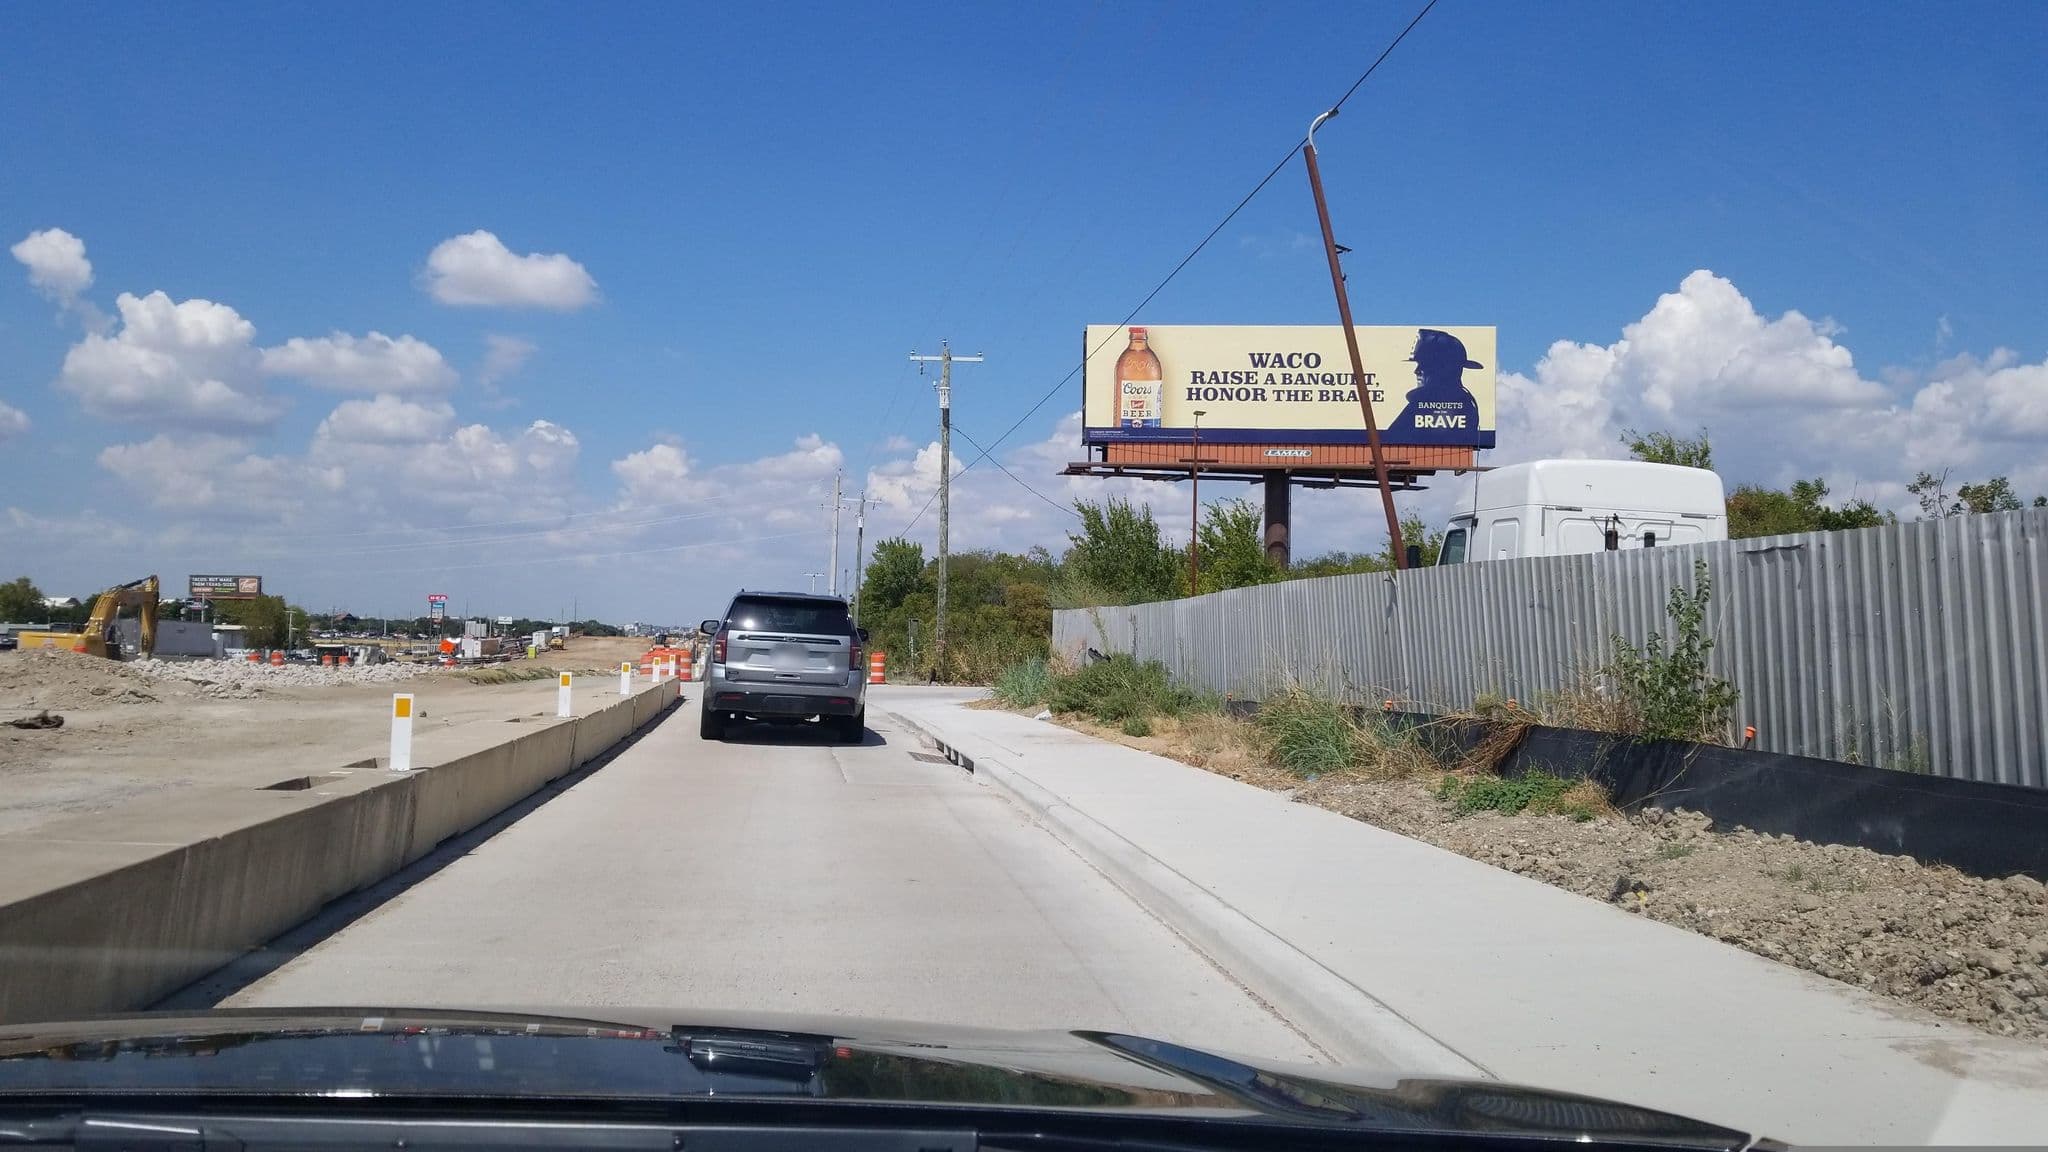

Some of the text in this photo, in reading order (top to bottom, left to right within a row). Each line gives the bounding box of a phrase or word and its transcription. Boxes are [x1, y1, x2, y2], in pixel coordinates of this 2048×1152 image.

[1248, 352, 1322, 369] WACO
[1190, 371, 1258, 385] RAISE
[1264, 373, 1277, 385] A
[1122, 382, 1152, 395] Coors
[1186, 388, 1385, 402] HONOR THE BRAE
[1414, 414, 1466, 428] BRAVE
[1268, 449, 1306, 457] LAMAR
